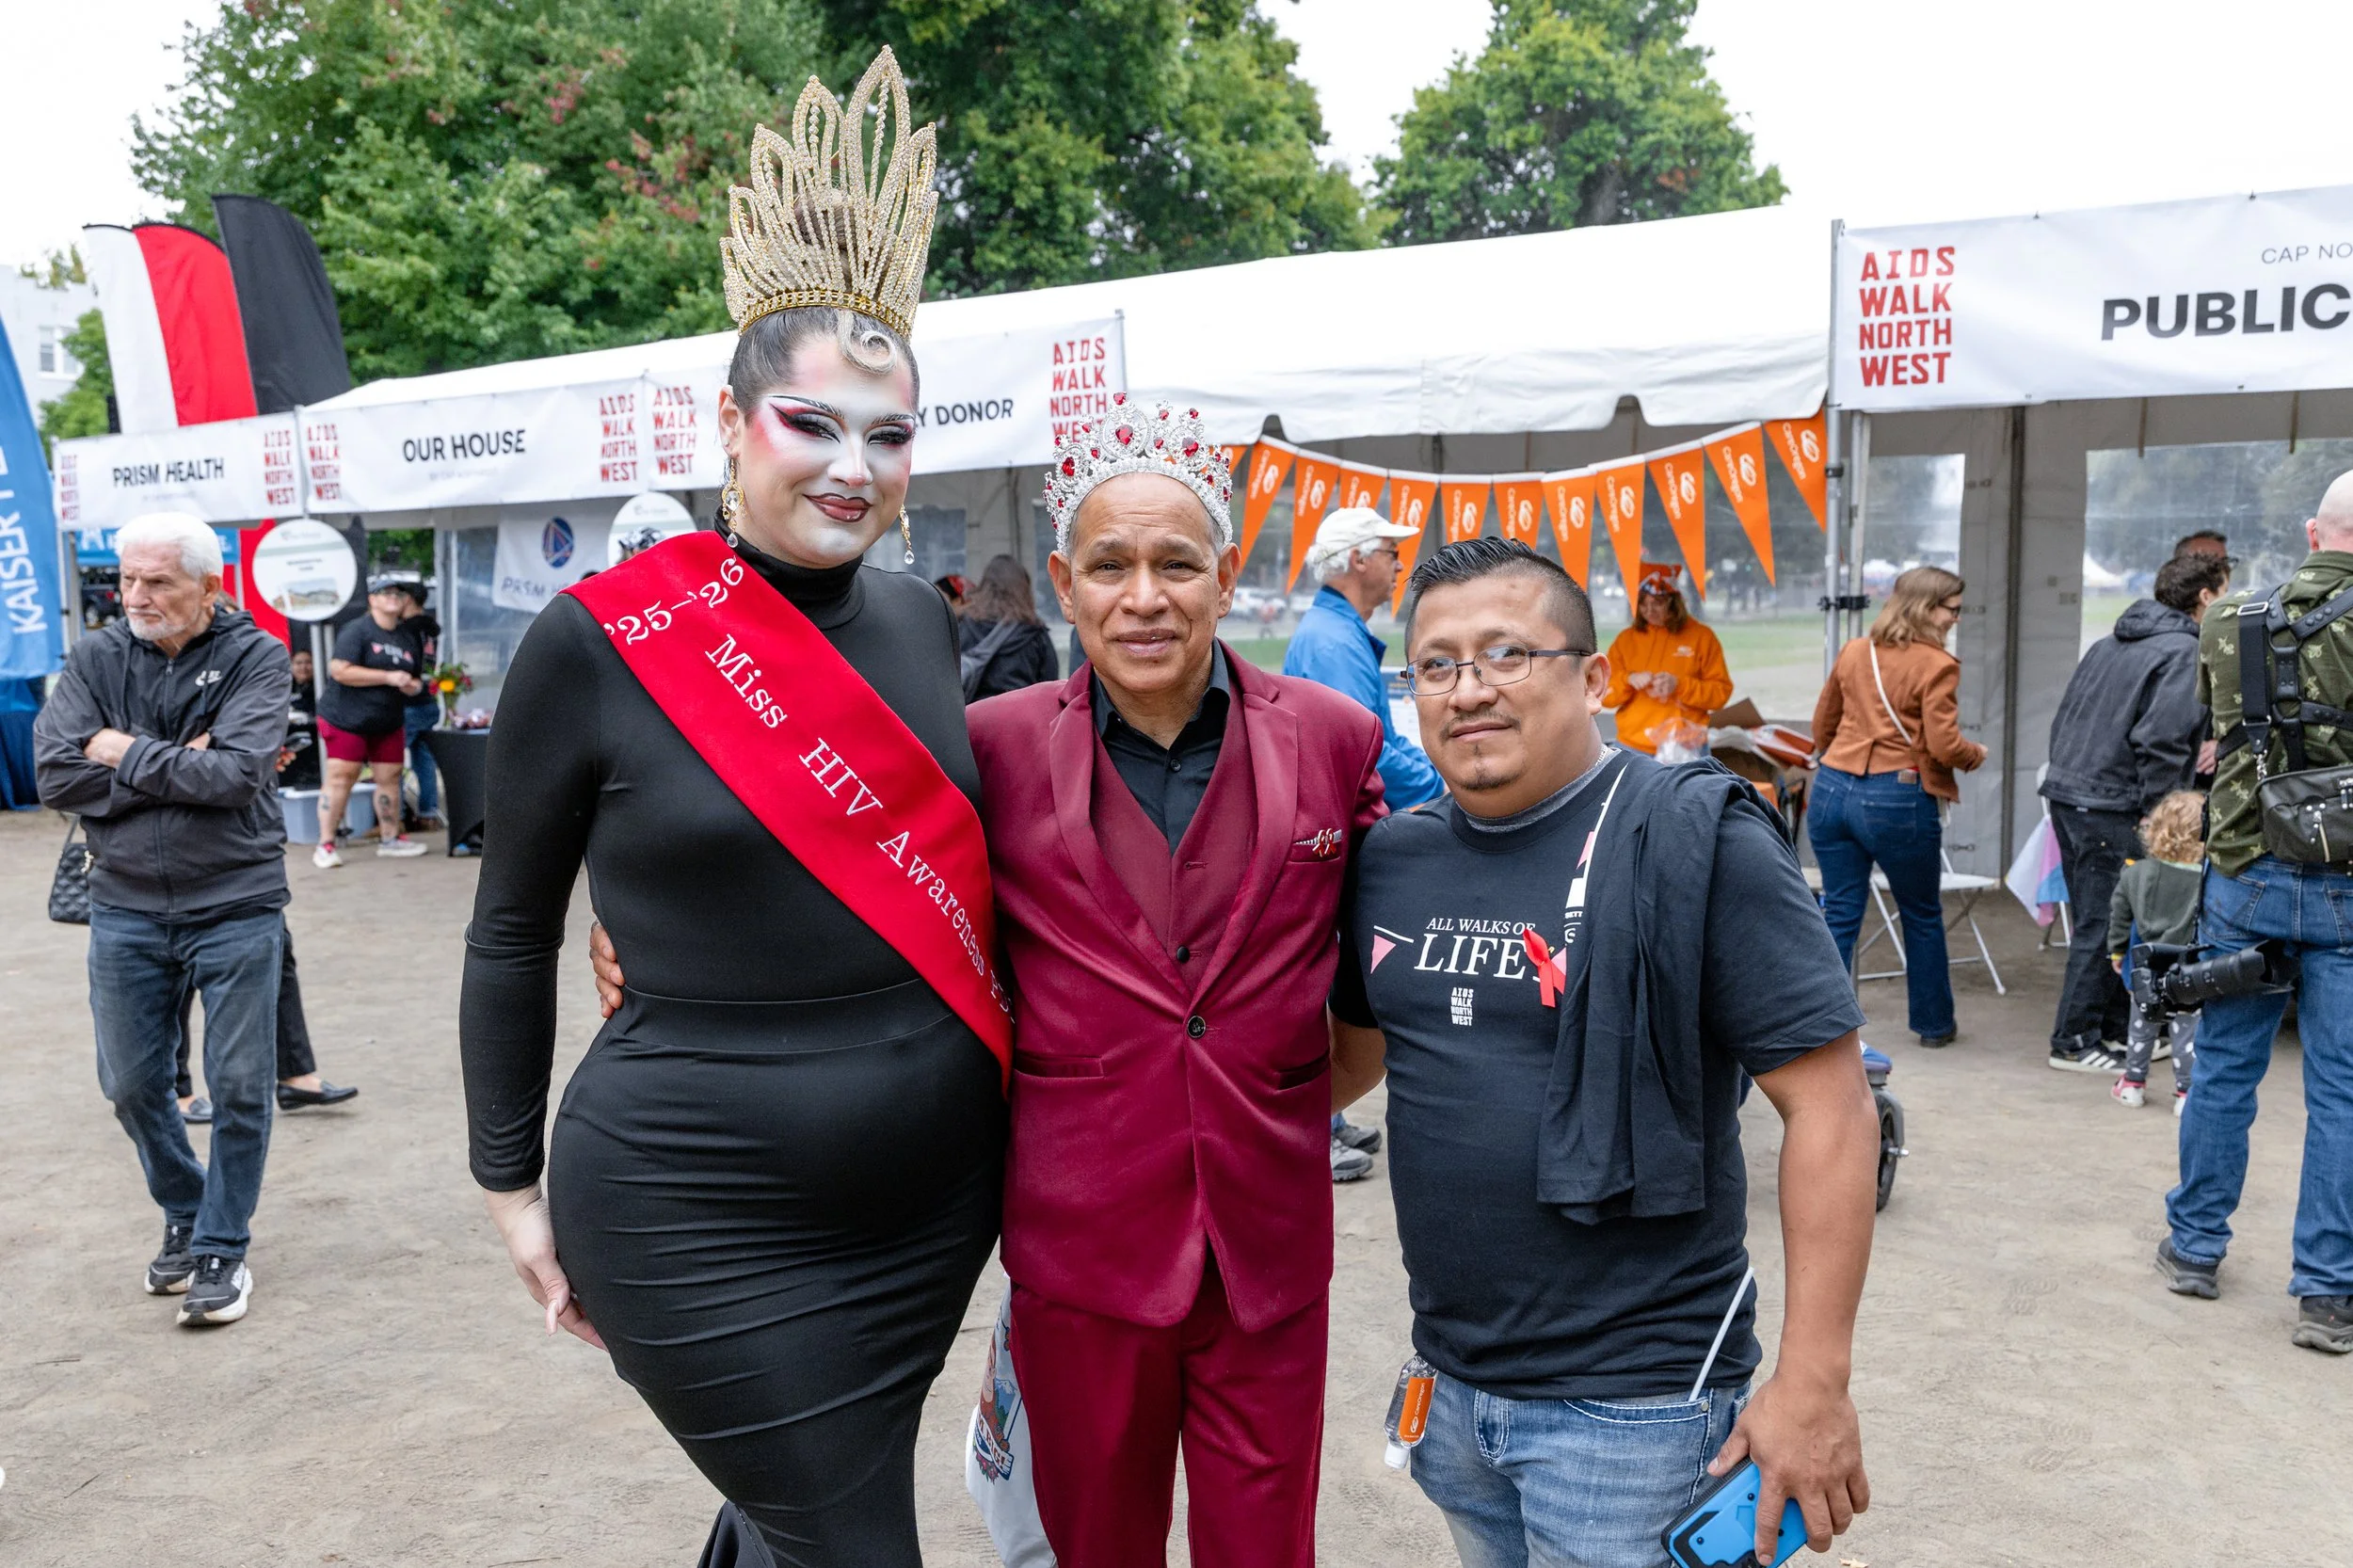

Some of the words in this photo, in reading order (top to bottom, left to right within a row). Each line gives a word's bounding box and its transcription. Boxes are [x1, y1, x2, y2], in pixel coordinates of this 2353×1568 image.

[1859, 246, 1957, 282] AIDS
[2261, 245, 2310, 264] CAP
[1859, 281, 1953, 318] WALK
[2101, 282, 2351, 342] PUBLIC
[1859, 317, 1953, 351] NORTH
[1052, 337, 1106, 366] AIDS
[1051, 365, 1107, 392] WALK
[1859, 351, 1953, 388] WEST
[599, 393, 635, 416] AIDS
[653, 386, 695, 407] AIDS
[1049, 392, 1108, 418] NORTH
[651, 408, 697, 430] WALK
[935, 398, 1015, 426] DONOR
[601, 416, 636, 438] WALK
[403, 436, 446, 462] OUR
[450, 428, 527, 460] HOUSE
[600, 440, 637, 459] NORTH
[652, 432, 697, 452] NORTH
[111, 463, 161, 488] PRISM
[165, 456, 225, 483] HEALTH
[599, 461, 638, 483] WEST
[655, 453, 696, 475] WEST
[704, 632, 789, 729] Miss
[798, 736, 884, 817] HIV
[874, 829, 985, 977] Awareness
[1425, 917, 1455, 932] ALL
[1458, 918, 1512, 935] WALKS
[1414, 933, 1527, 980] LIFE
[1450, 986, 1475, 999] AIDS
[1450, 996, 1473, 1008] WALK
[1450, 1005, 1473, 1016] NORTH
[1451, 1015, 1473, 1027] WEST
